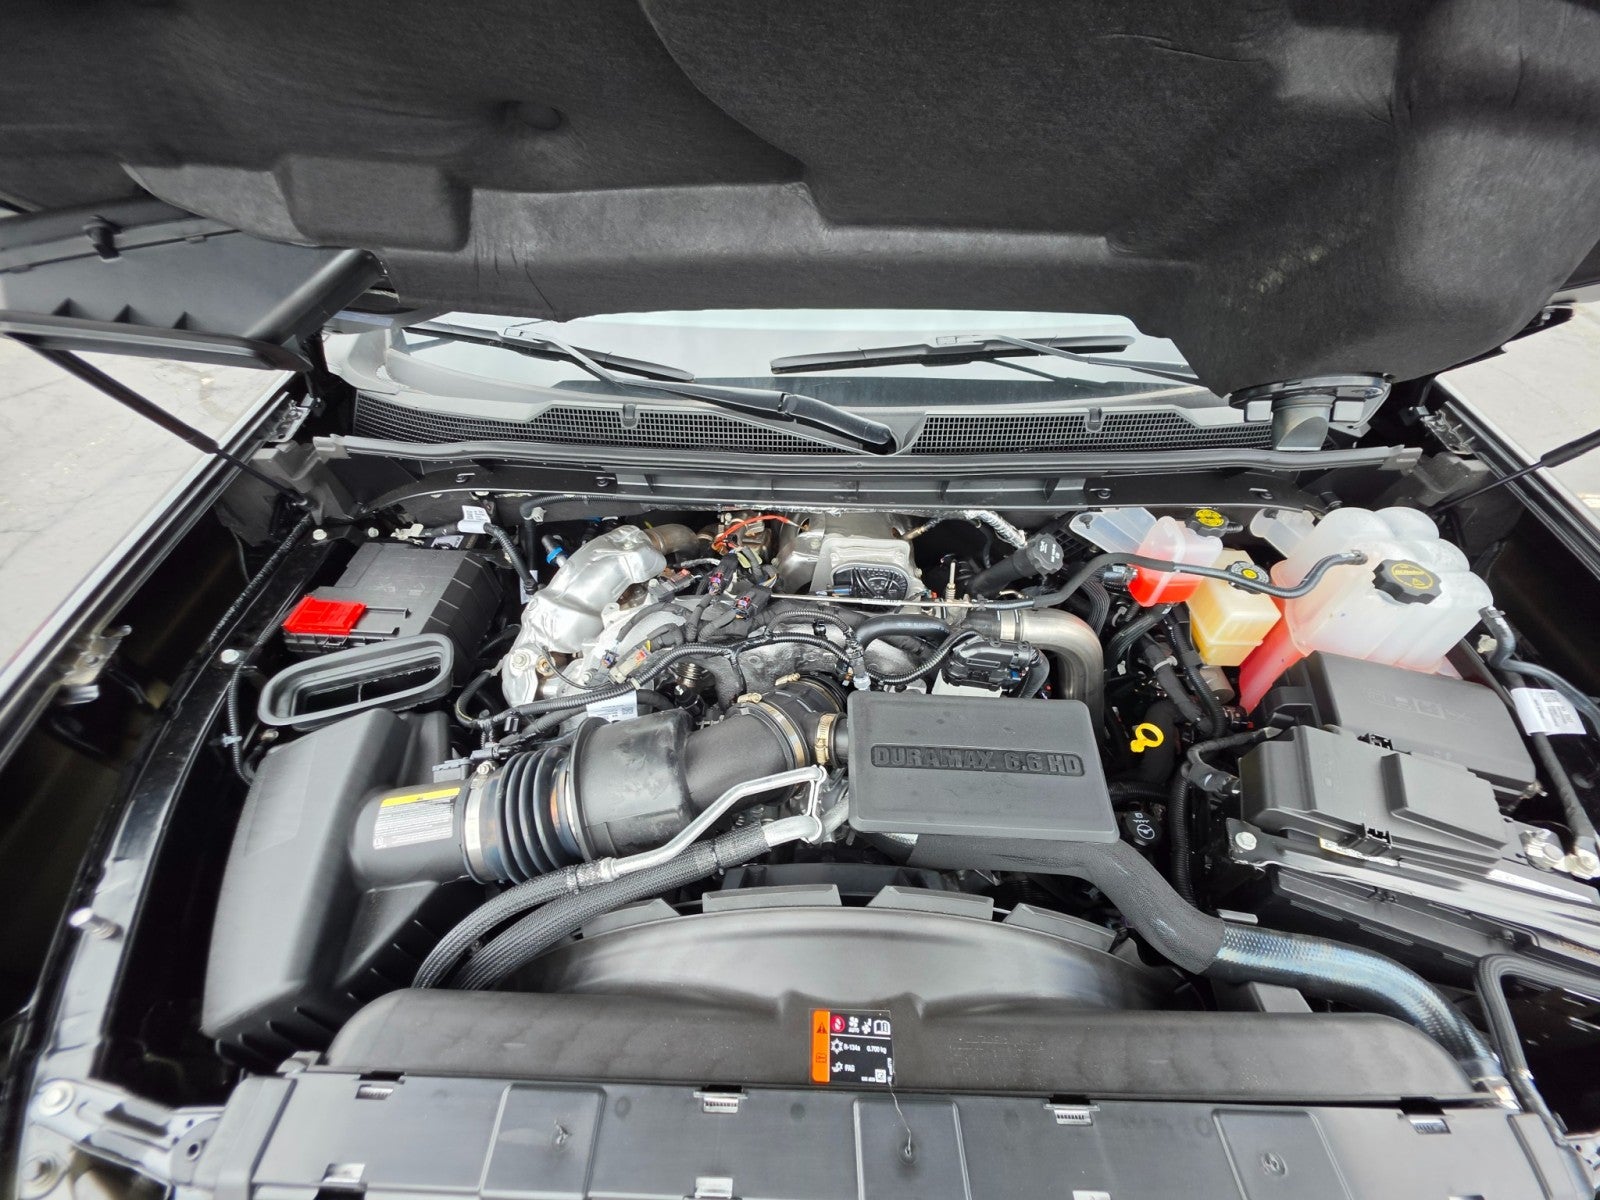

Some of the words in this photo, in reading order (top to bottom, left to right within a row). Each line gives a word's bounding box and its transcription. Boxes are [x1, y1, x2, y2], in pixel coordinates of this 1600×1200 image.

[874, 746, 996, 769] DURAMAX
[1004, 752, 1042, 772] 6.6
[1047, 754, 1082, 774] HD
